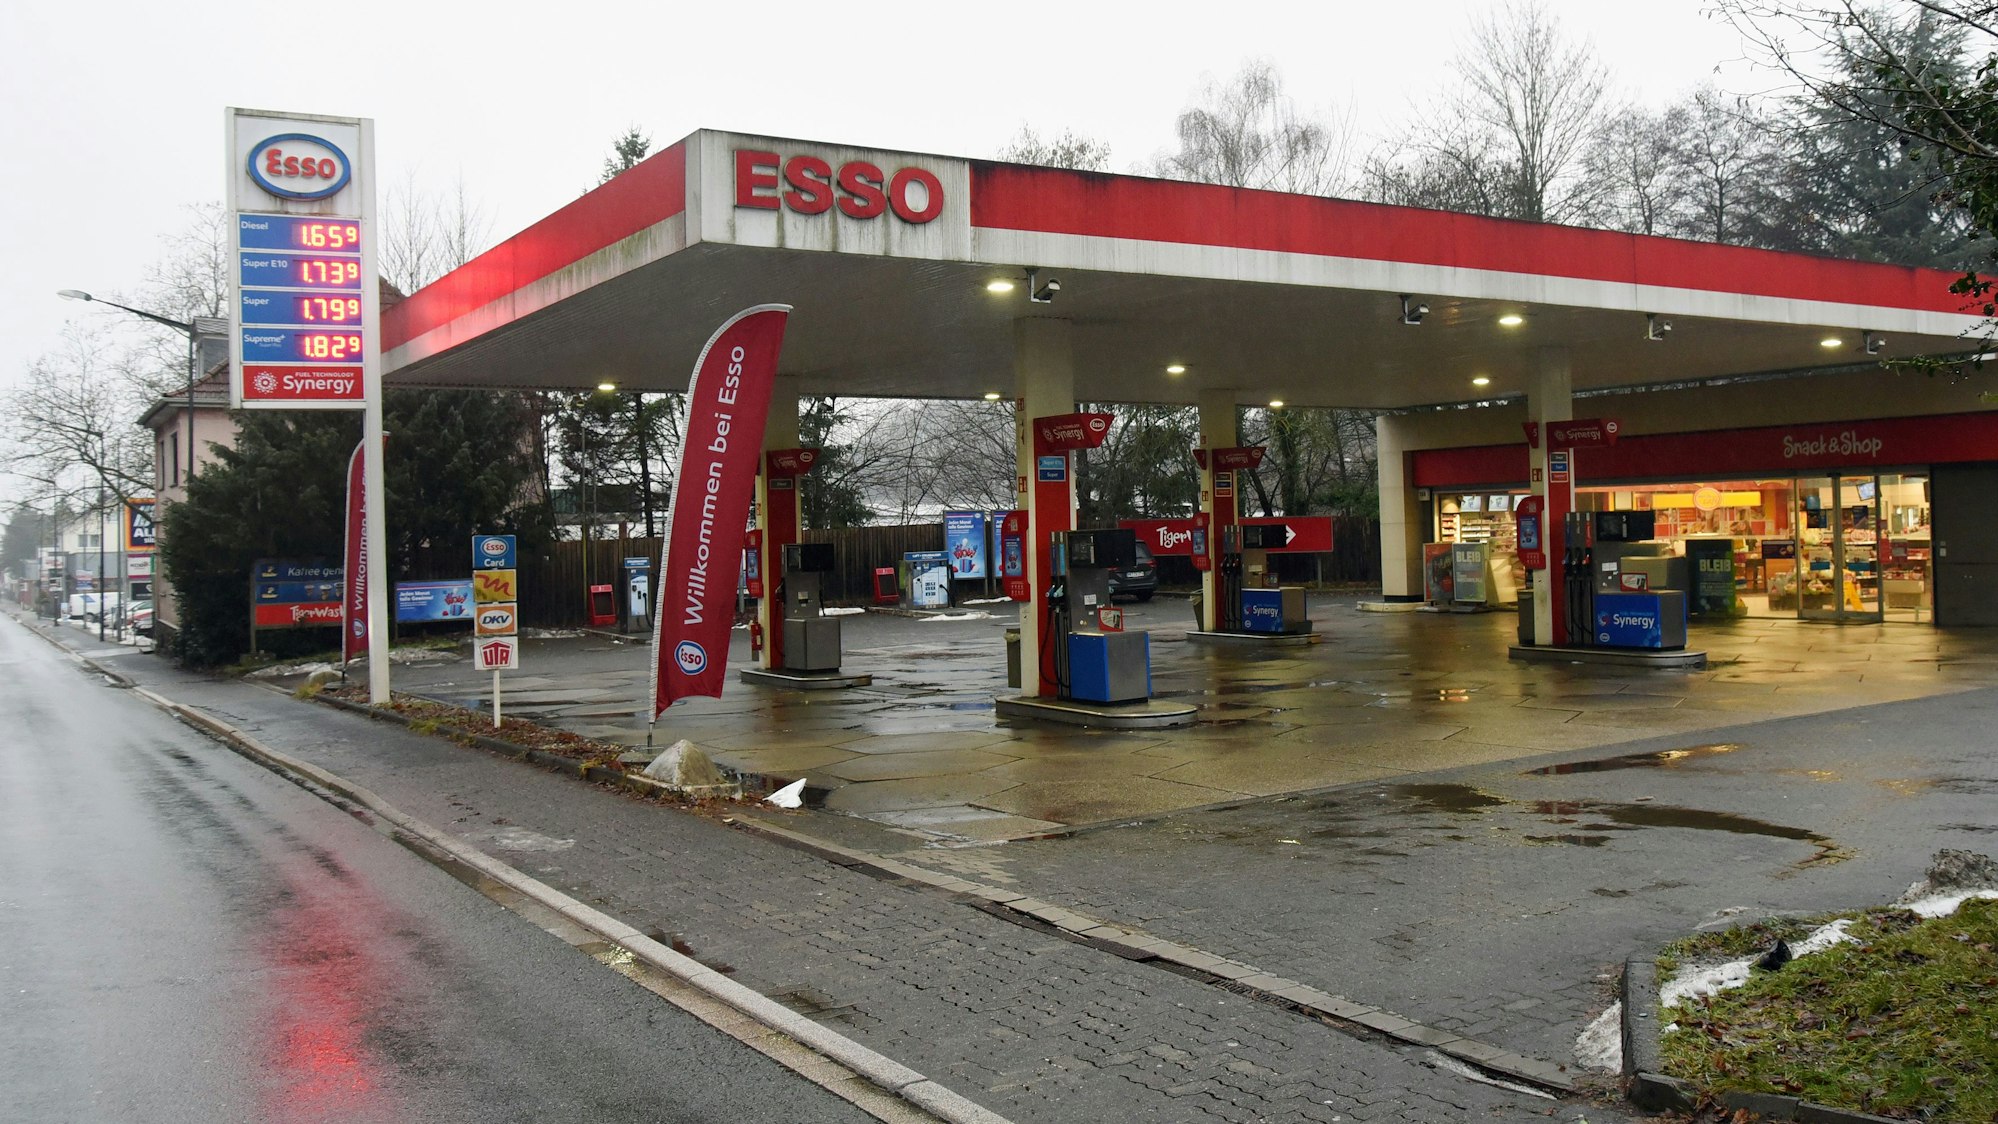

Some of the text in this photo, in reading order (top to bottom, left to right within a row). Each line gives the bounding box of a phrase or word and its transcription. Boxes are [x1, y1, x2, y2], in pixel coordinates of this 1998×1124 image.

[266, 148, 336, 179] Esso
[735, 150, 944, 224] ESSO
[241, 221, 268, 230] Diesel
[243, 259, 288, 268] Super E10
[243, 297, 269, 306] Super
[283, 375, 355, 394] Synergy
[1052, 428, 1085, 442] Synergy
[1565, 430, 1600, 441] Synergy
[684, 345, 745, 625] Willkommen bei Esso
[486, 543, 504, 551] Esso
[484, 558, 505, 568] Card
[1456, 551, 1481, 563] BLEIB
[1699, 559, 1731, 571] BLEIB
[1252, 604, 1279, 618] Synergy
[482, 614, 510, 625] DKV
[1612, 613, 1655, 629] Synergy
[482, 641, 511, 666] UTA
